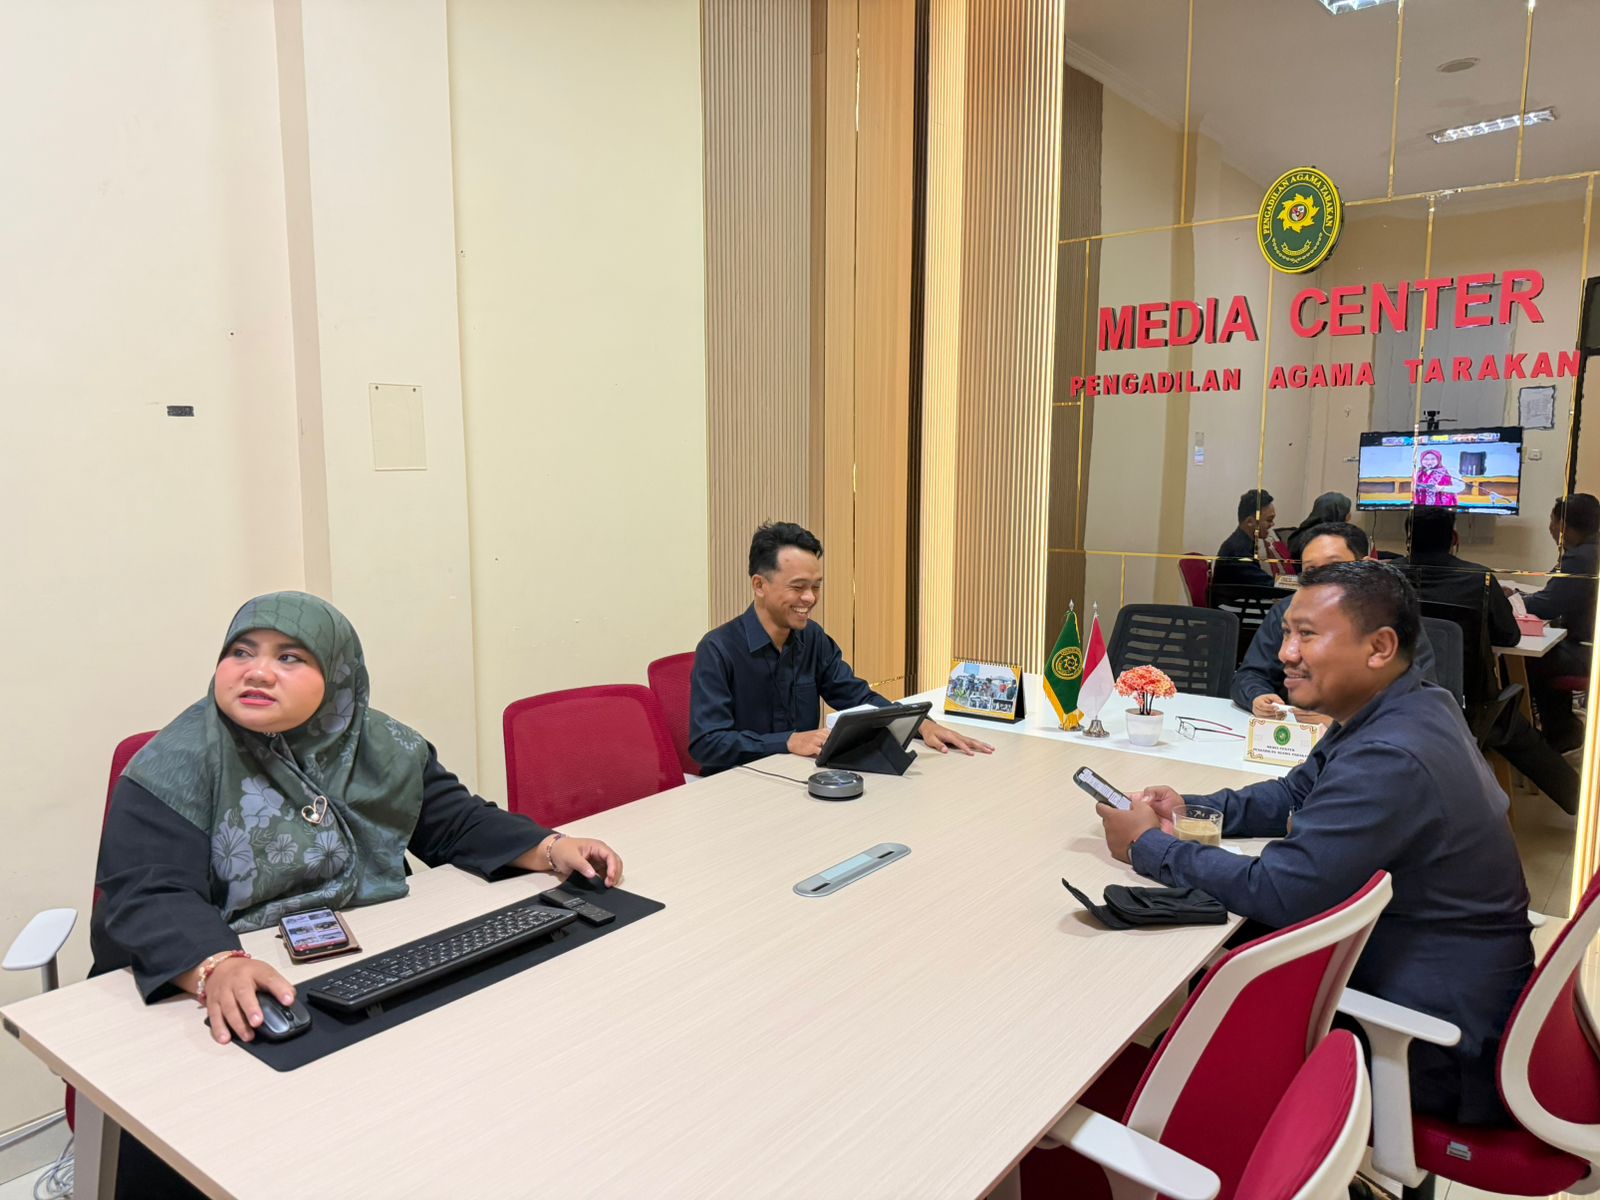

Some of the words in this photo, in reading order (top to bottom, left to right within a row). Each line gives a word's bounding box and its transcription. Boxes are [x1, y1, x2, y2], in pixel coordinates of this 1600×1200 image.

[1263, 180, 1290, 235] PENGADILAN
[1291, 173, 1322, 188] AGAMA
[1319, 183, 1334, 227] TARAKAN
[1098, 295, 1259, 351] MEDIA
[1289, 269, 1545, 338] CENTER
[1070, 368, 1241, 398] PENGADILAN
[1269, 361, 1375, 389] AGAMA
[1404, 350, 1581, 384] TARAKAN
